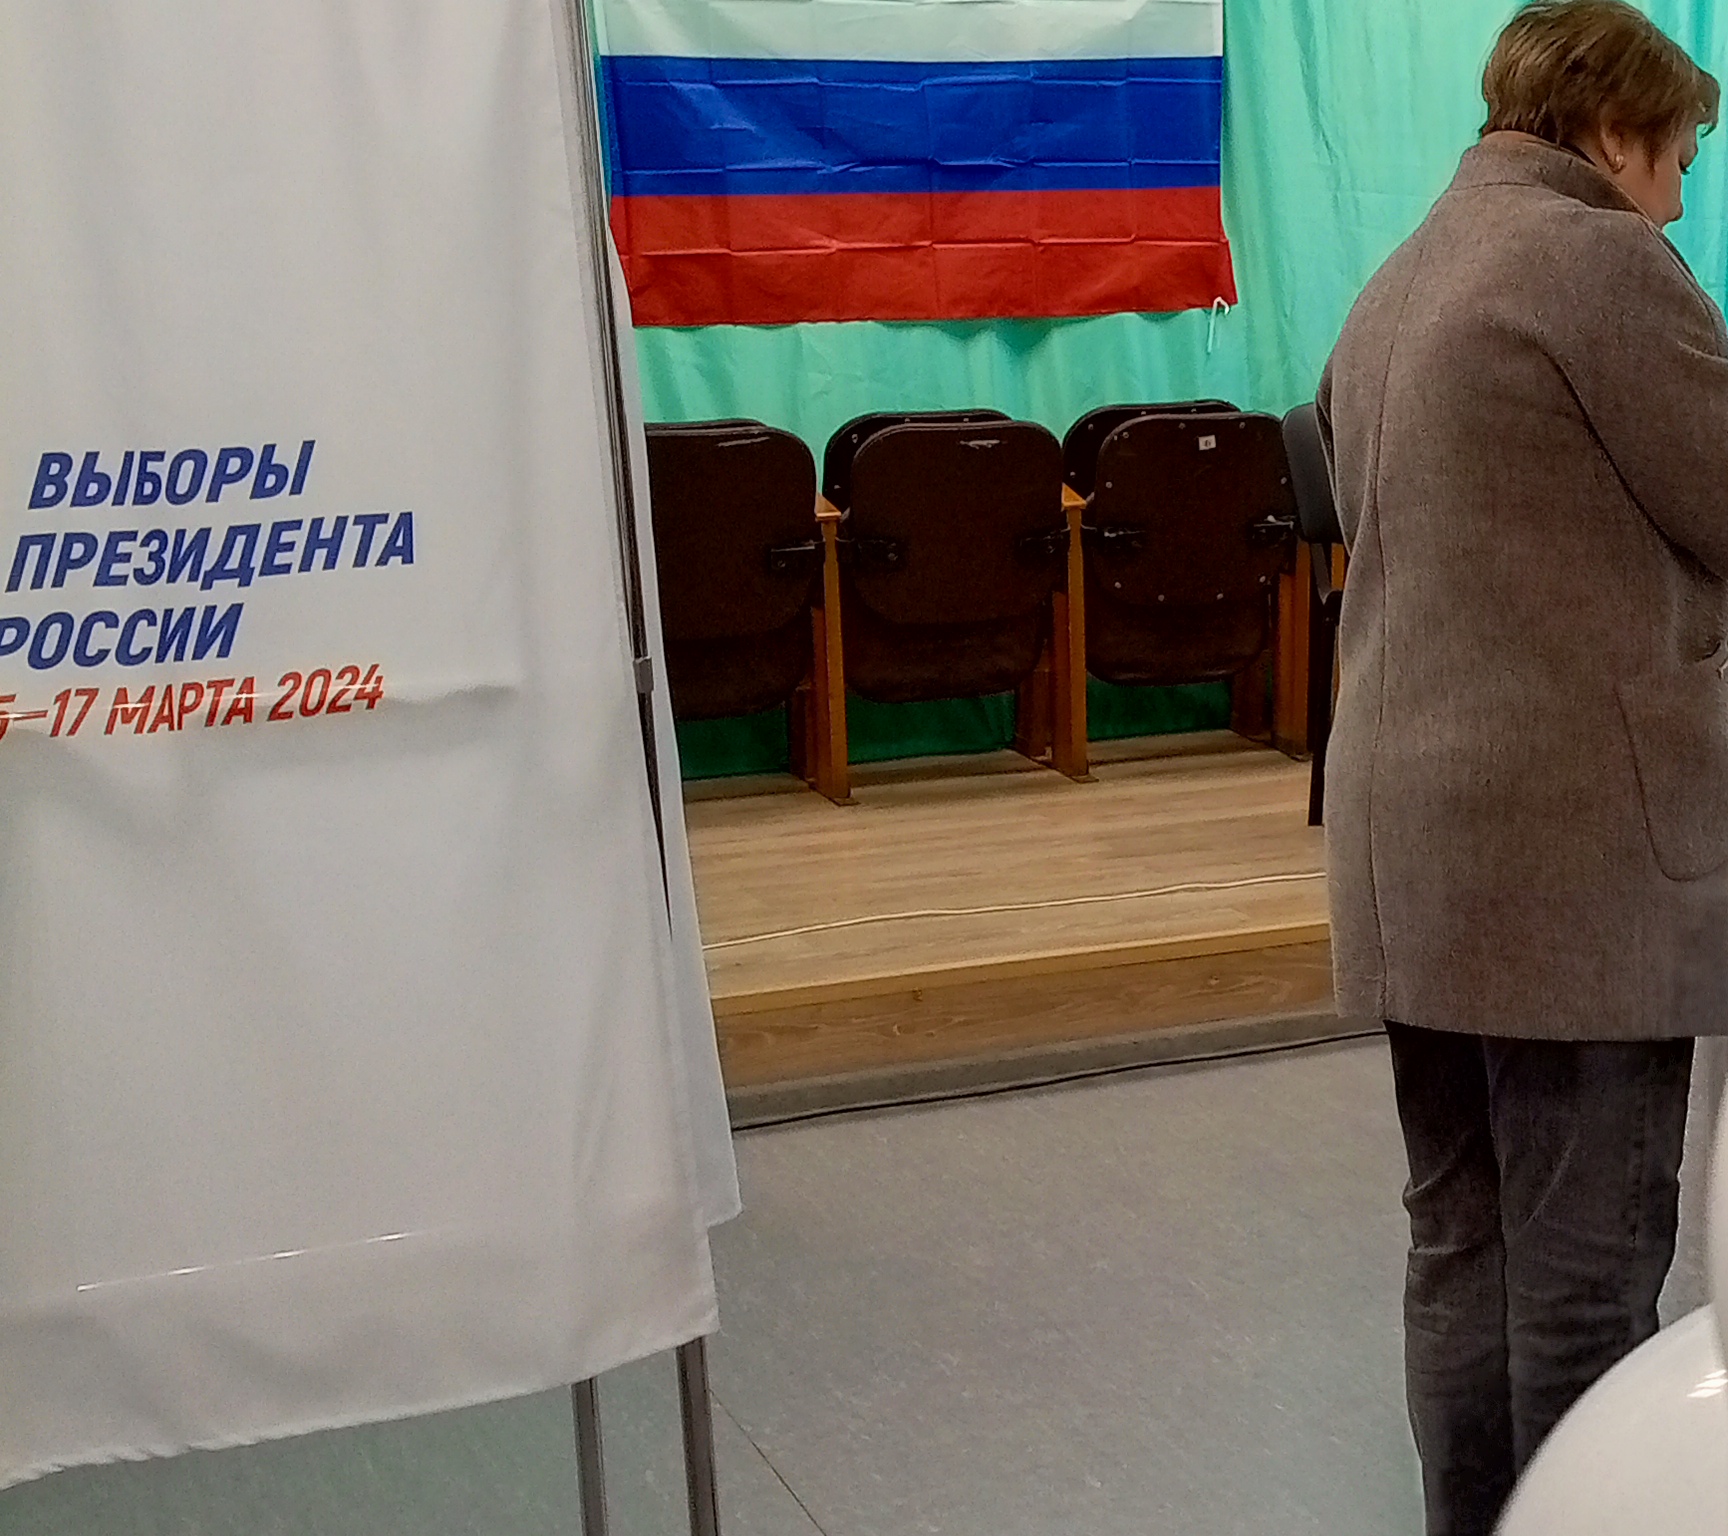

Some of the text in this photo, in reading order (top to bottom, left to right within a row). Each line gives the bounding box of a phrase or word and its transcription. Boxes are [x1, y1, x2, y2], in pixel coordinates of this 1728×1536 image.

[28, 440, 315, 509] ВЫБОРЫ
[5, 511, 414, 592] ПРЕЗИДЕНТА
[0, 602, 244, 670] РОССИИ
[104, 676, 254, 735] МАРТА
[267, 664, 384, 722] 2024
